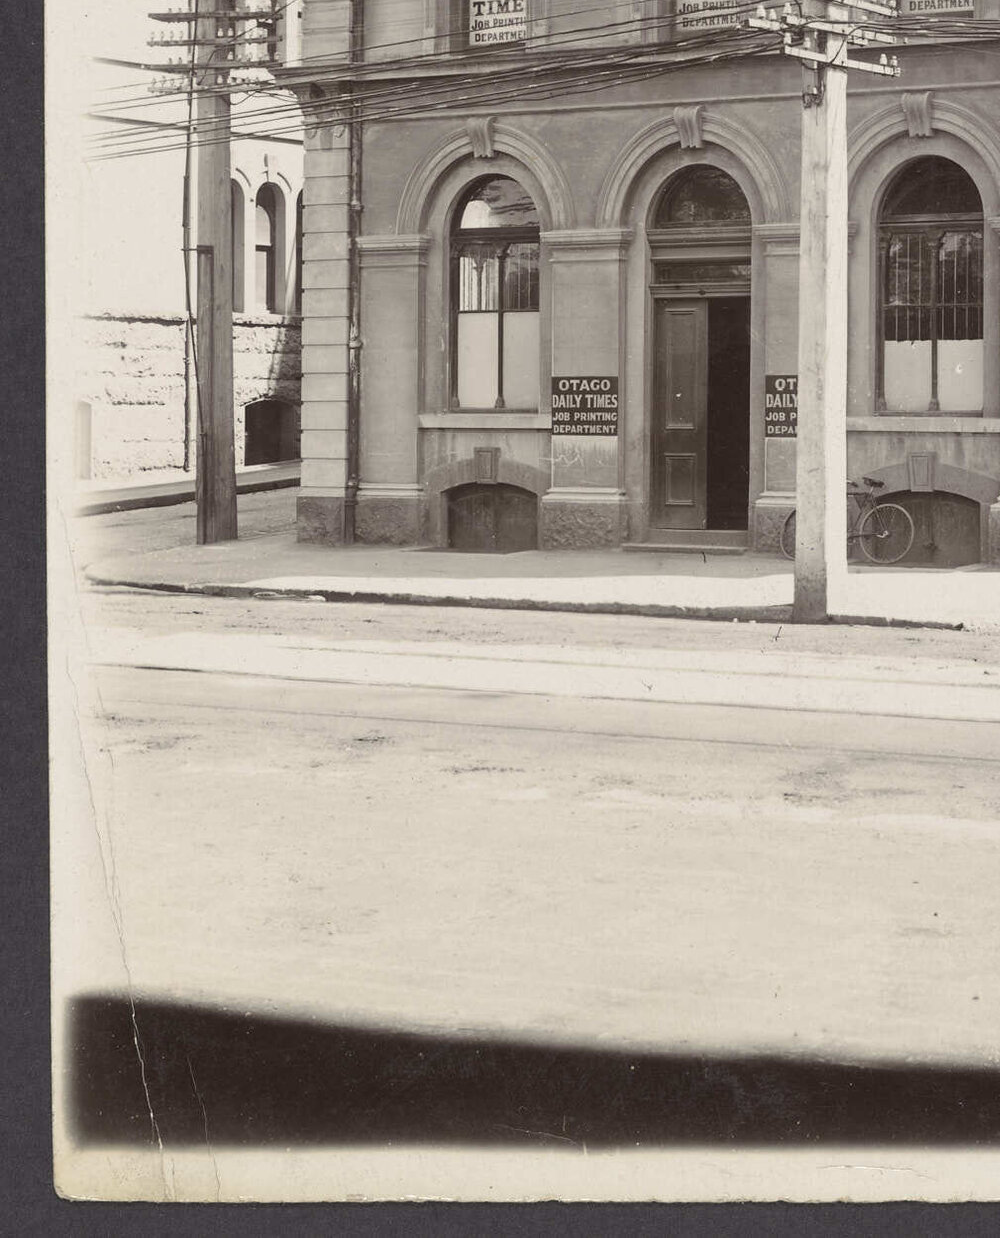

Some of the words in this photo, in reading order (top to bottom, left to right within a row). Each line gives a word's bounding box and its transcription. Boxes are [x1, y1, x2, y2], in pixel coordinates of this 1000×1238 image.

[471, 19, 490, 31] JOB
[493, 16, 526, 28] PRINTI
[559, 379, 610, 391] OTAGO
[552, 394, 582, 408] DAILY
[585, 394, 618, 408] TIMES
[766, 393, 798, 408] DAILY
[553, 412, 570, 421] JOB
[574, 412, 617, 421] PRINTING
[766, 412, 786, 421] JOB
[554, 424, 616, 433] DEPARTMENT
[768, 425, 797, 434] DEPA
